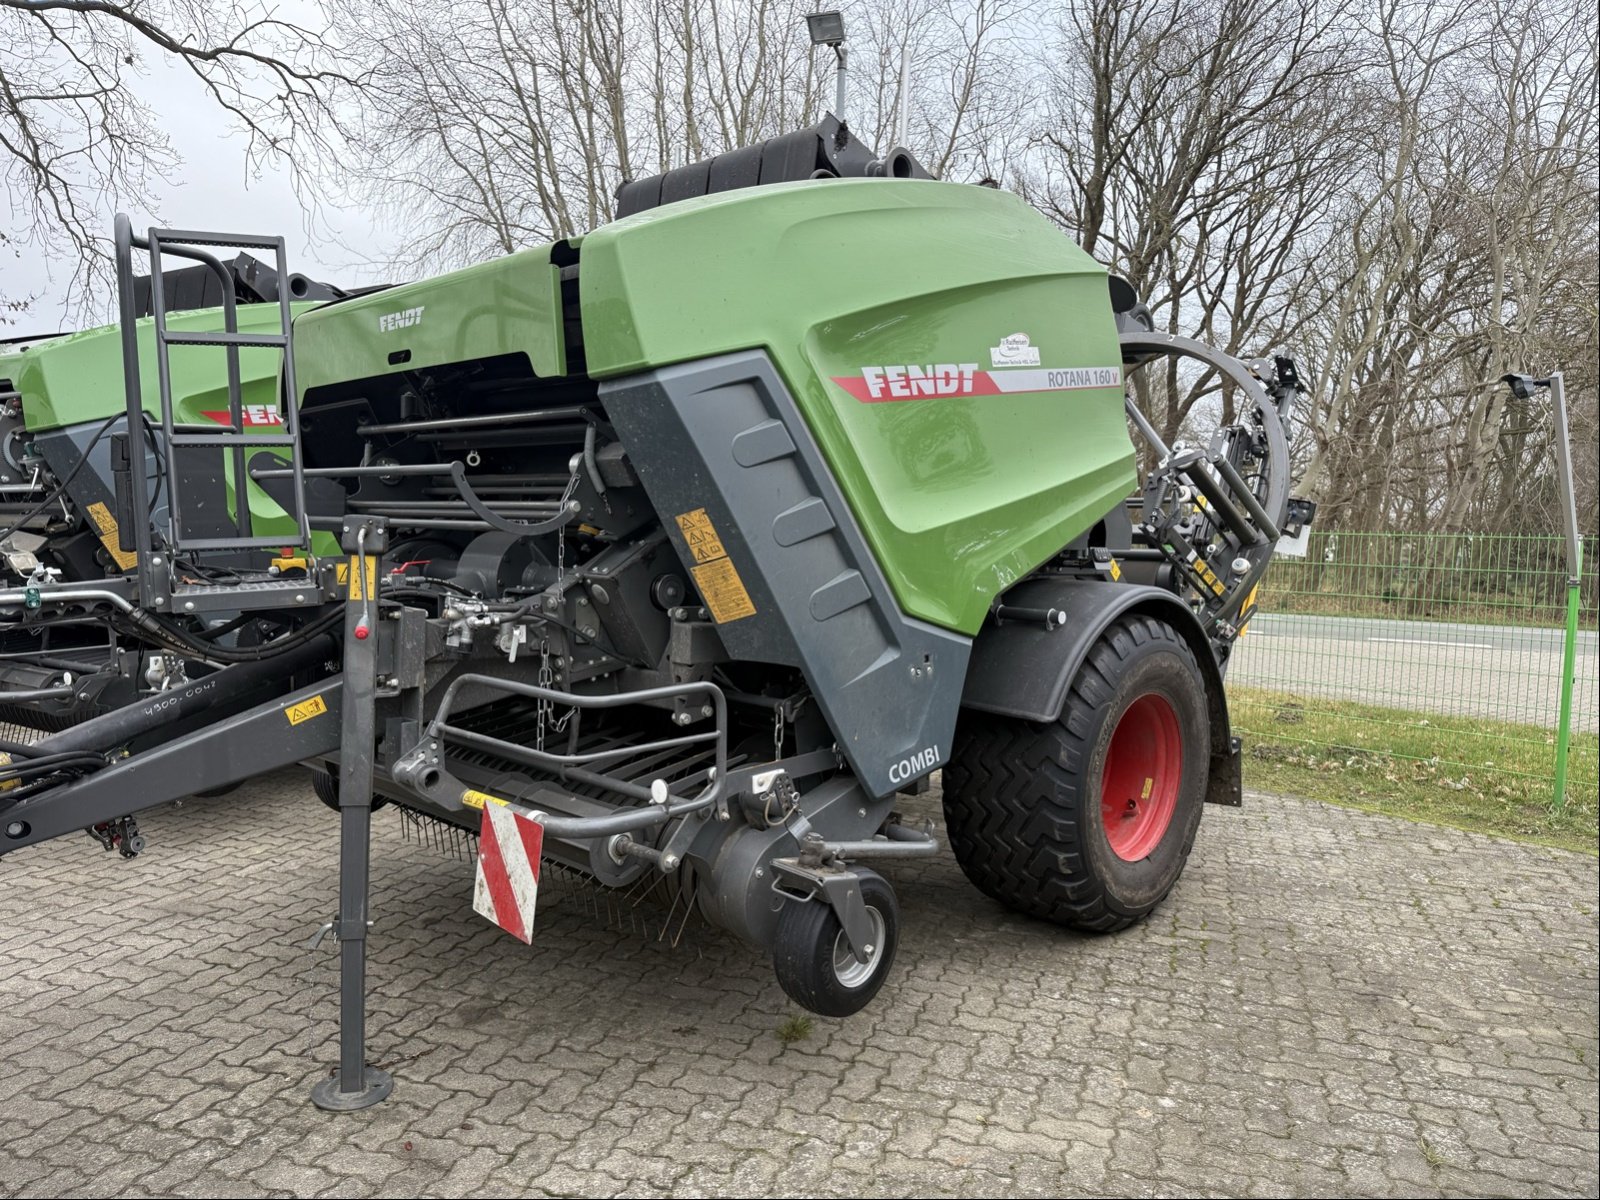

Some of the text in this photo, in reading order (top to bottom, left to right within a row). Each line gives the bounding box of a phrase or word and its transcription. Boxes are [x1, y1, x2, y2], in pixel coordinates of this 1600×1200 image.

[379, 305, 425, 333] FENDT
[861, 362, 979, 398] FENDT
[1047, 369, 1092, 388] ROTANA
[1093, 369, 1111, 385] 160
[888, 744, 941, 784] COMBI
